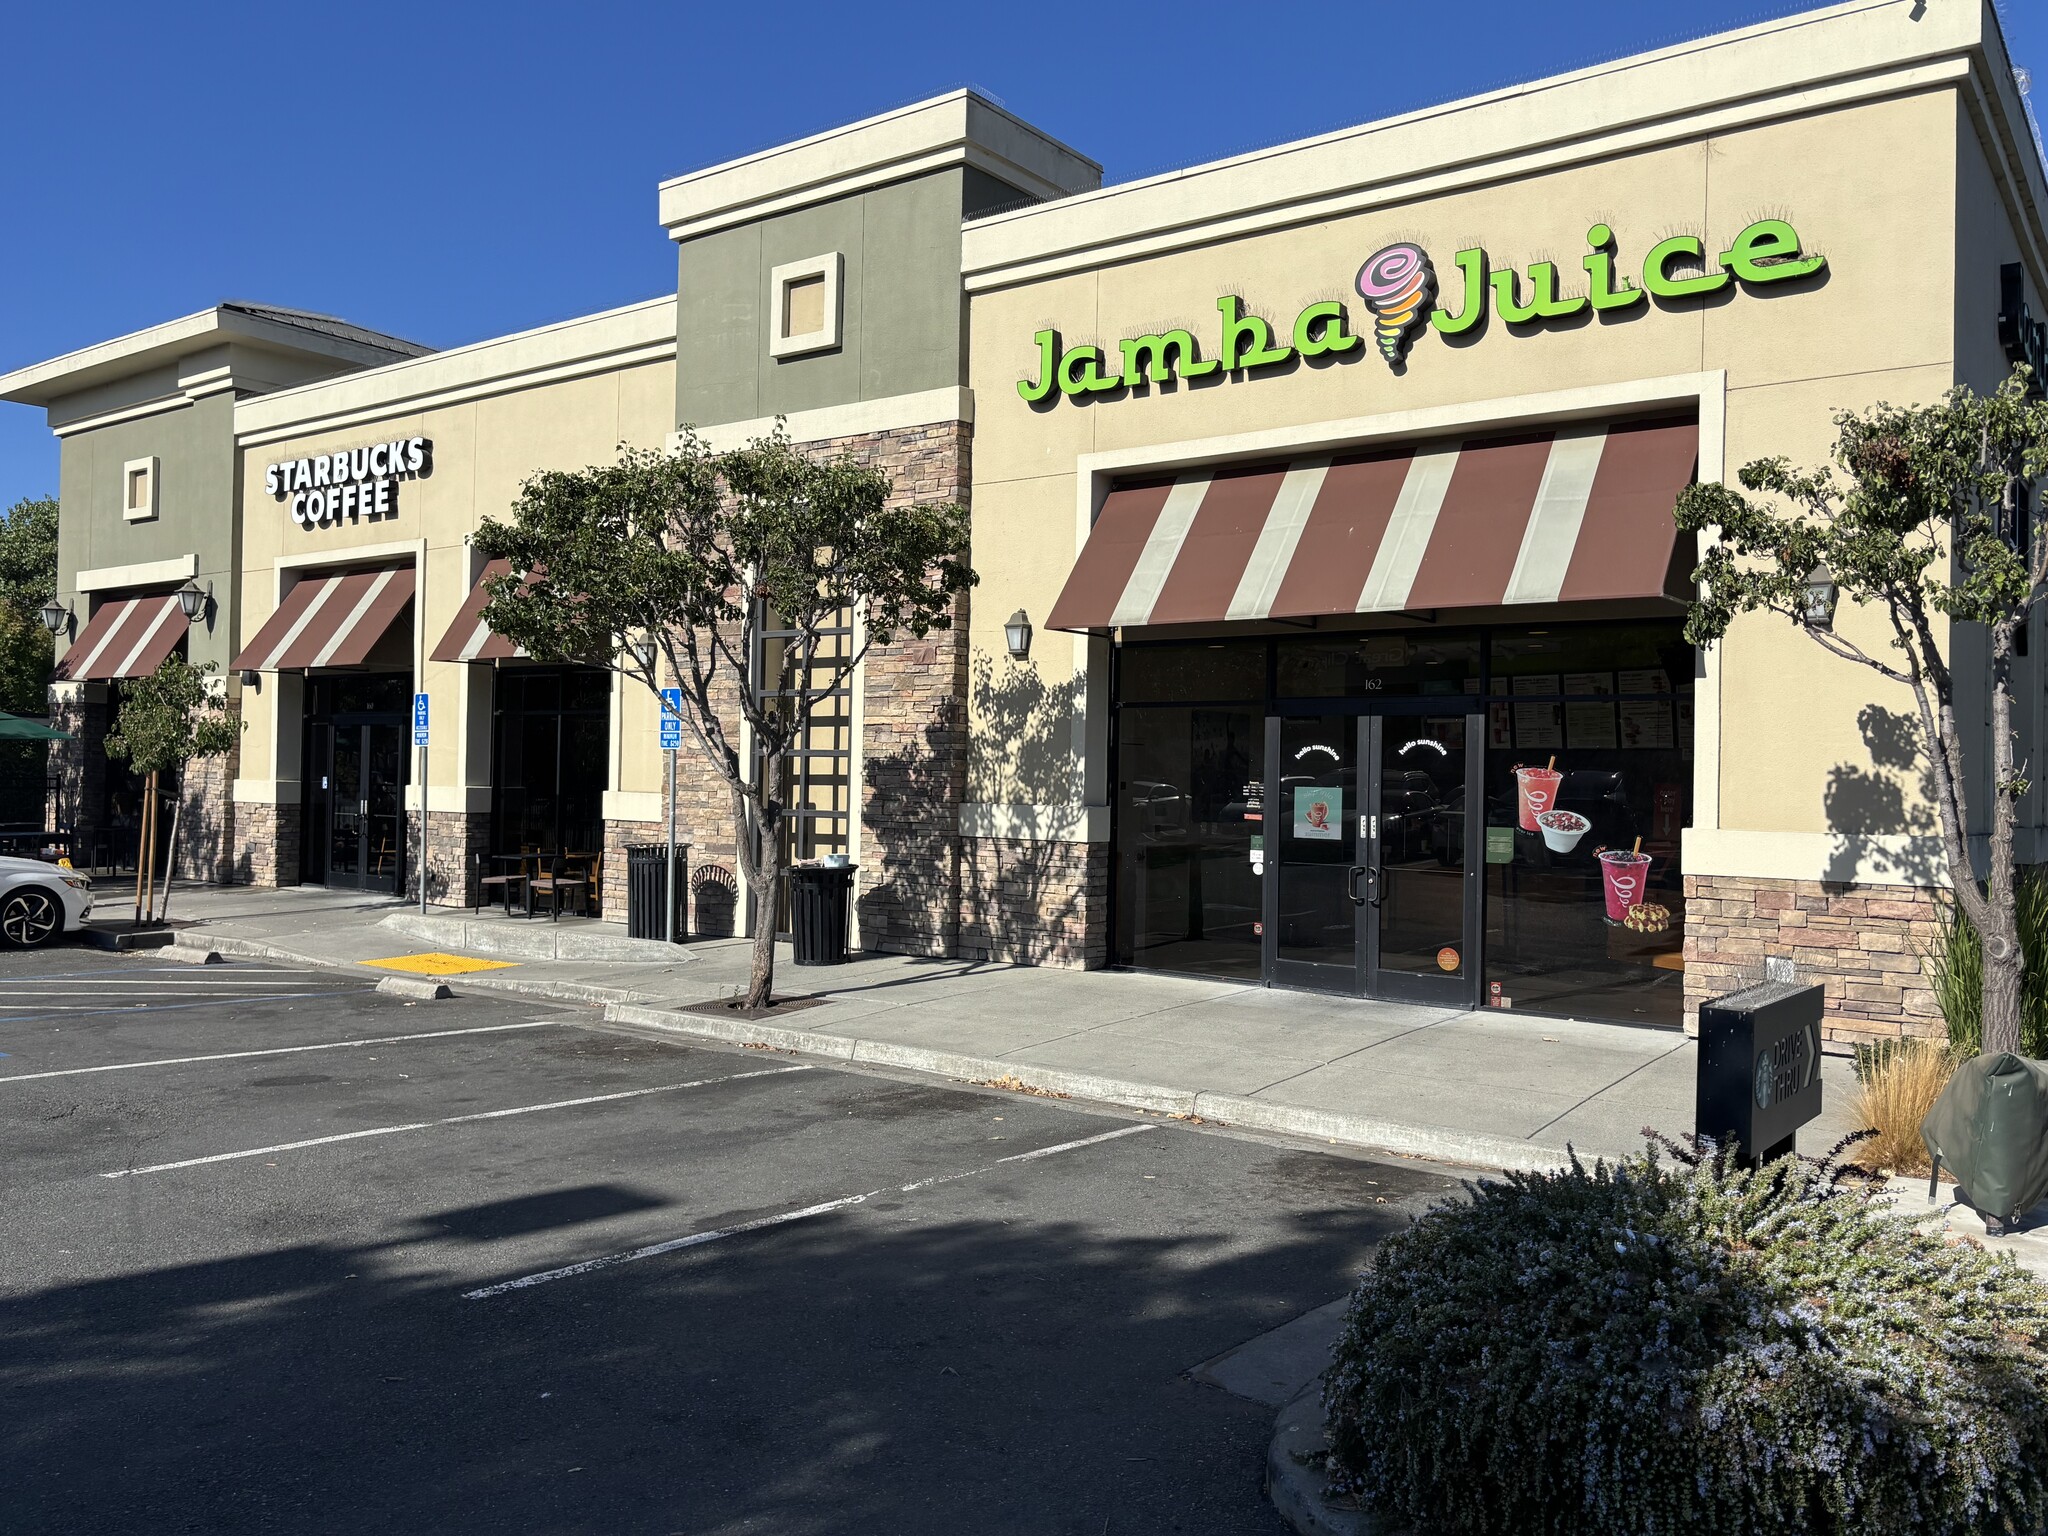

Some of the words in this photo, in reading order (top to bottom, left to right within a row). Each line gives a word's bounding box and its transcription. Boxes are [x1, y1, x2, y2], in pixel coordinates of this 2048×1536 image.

[1016, 294, 1365, 404] Jamba
[1430, 217, 1827, 336] Juice
[264, 436, 428, 496] STARBUCKS
[290, 479, 394, 526] COFFEE
[1364, 678, 1383, 690] 162
[664, 722, 676, 730] ONLY
[1294, 746, 1312, 760] hello
[1312, 744, 1340, 761] sunshine
[1398, 741, 1417, 756] hello
[1416, 739, 1448, 756] sunshine
[1510, 763, 1524, 774] new
[1773, 1029, 1803, 1071] DRIVE
[1773, 1064, 1801, 1105] THRU
